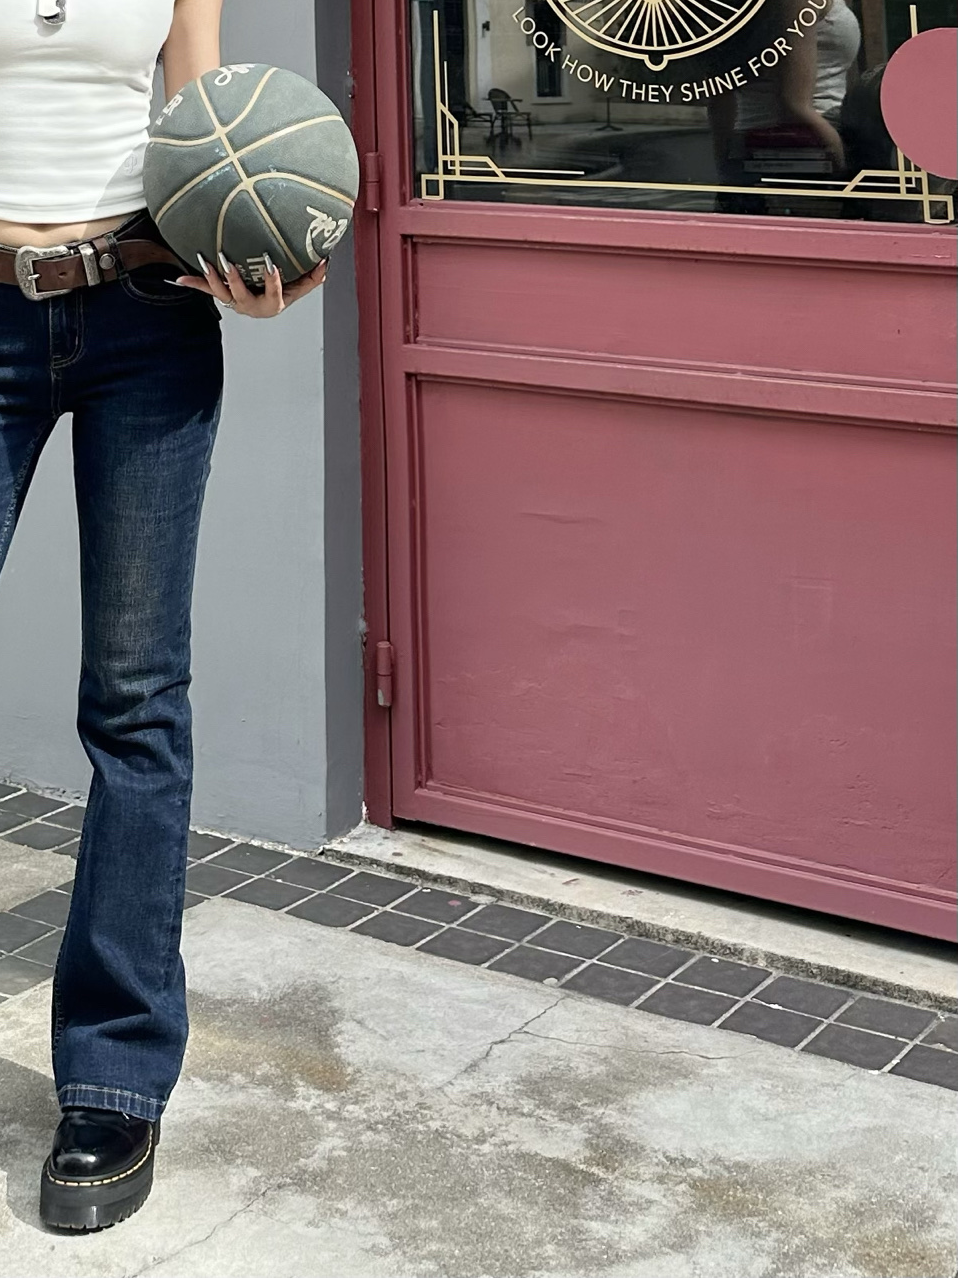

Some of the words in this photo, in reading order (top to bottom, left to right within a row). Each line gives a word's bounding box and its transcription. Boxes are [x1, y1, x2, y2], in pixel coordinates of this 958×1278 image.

[511, 6, 562, 62] LOOK
[561, 54, 615, 93] HOW
[619, 78, 674, 103] THEY
[680, 67, 748, 102] SHINE
[748, 37, 792, 77] FOR
